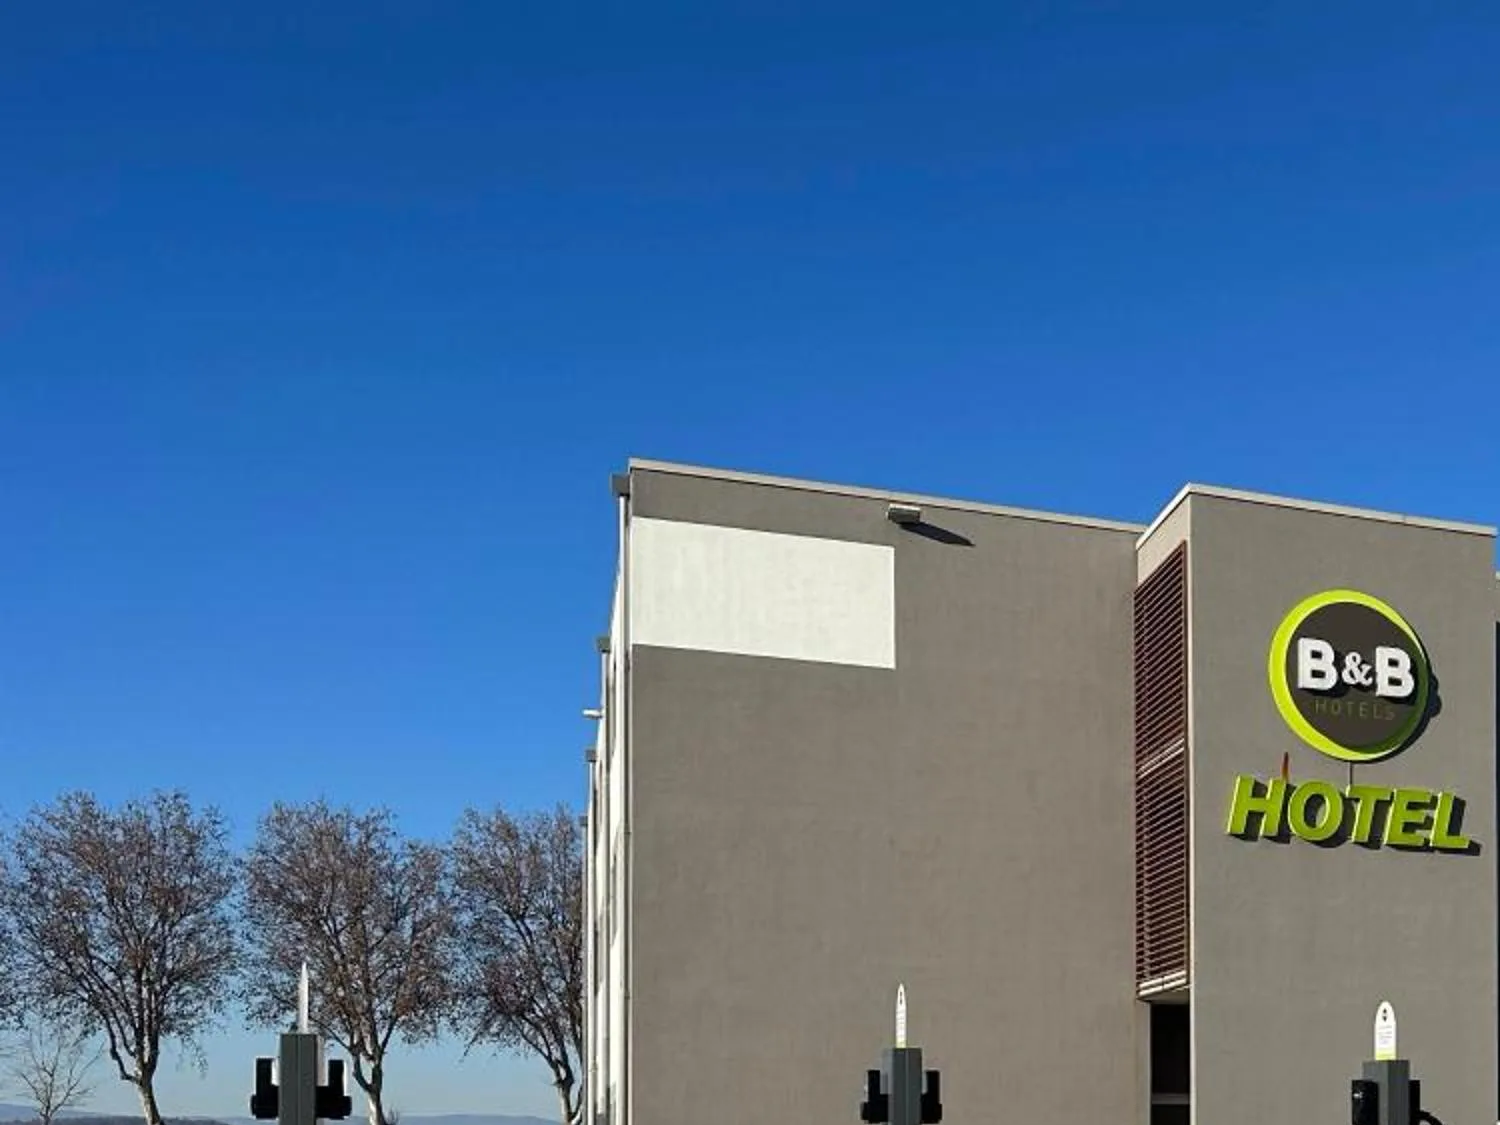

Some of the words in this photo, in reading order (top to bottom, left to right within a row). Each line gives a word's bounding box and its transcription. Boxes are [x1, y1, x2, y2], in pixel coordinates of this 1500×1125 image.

[1297, 637, 1415, 698] B&B
[1314, 699, 1395, 721] HOTELS
[1226, 775, 1471, 849] HOTEL
